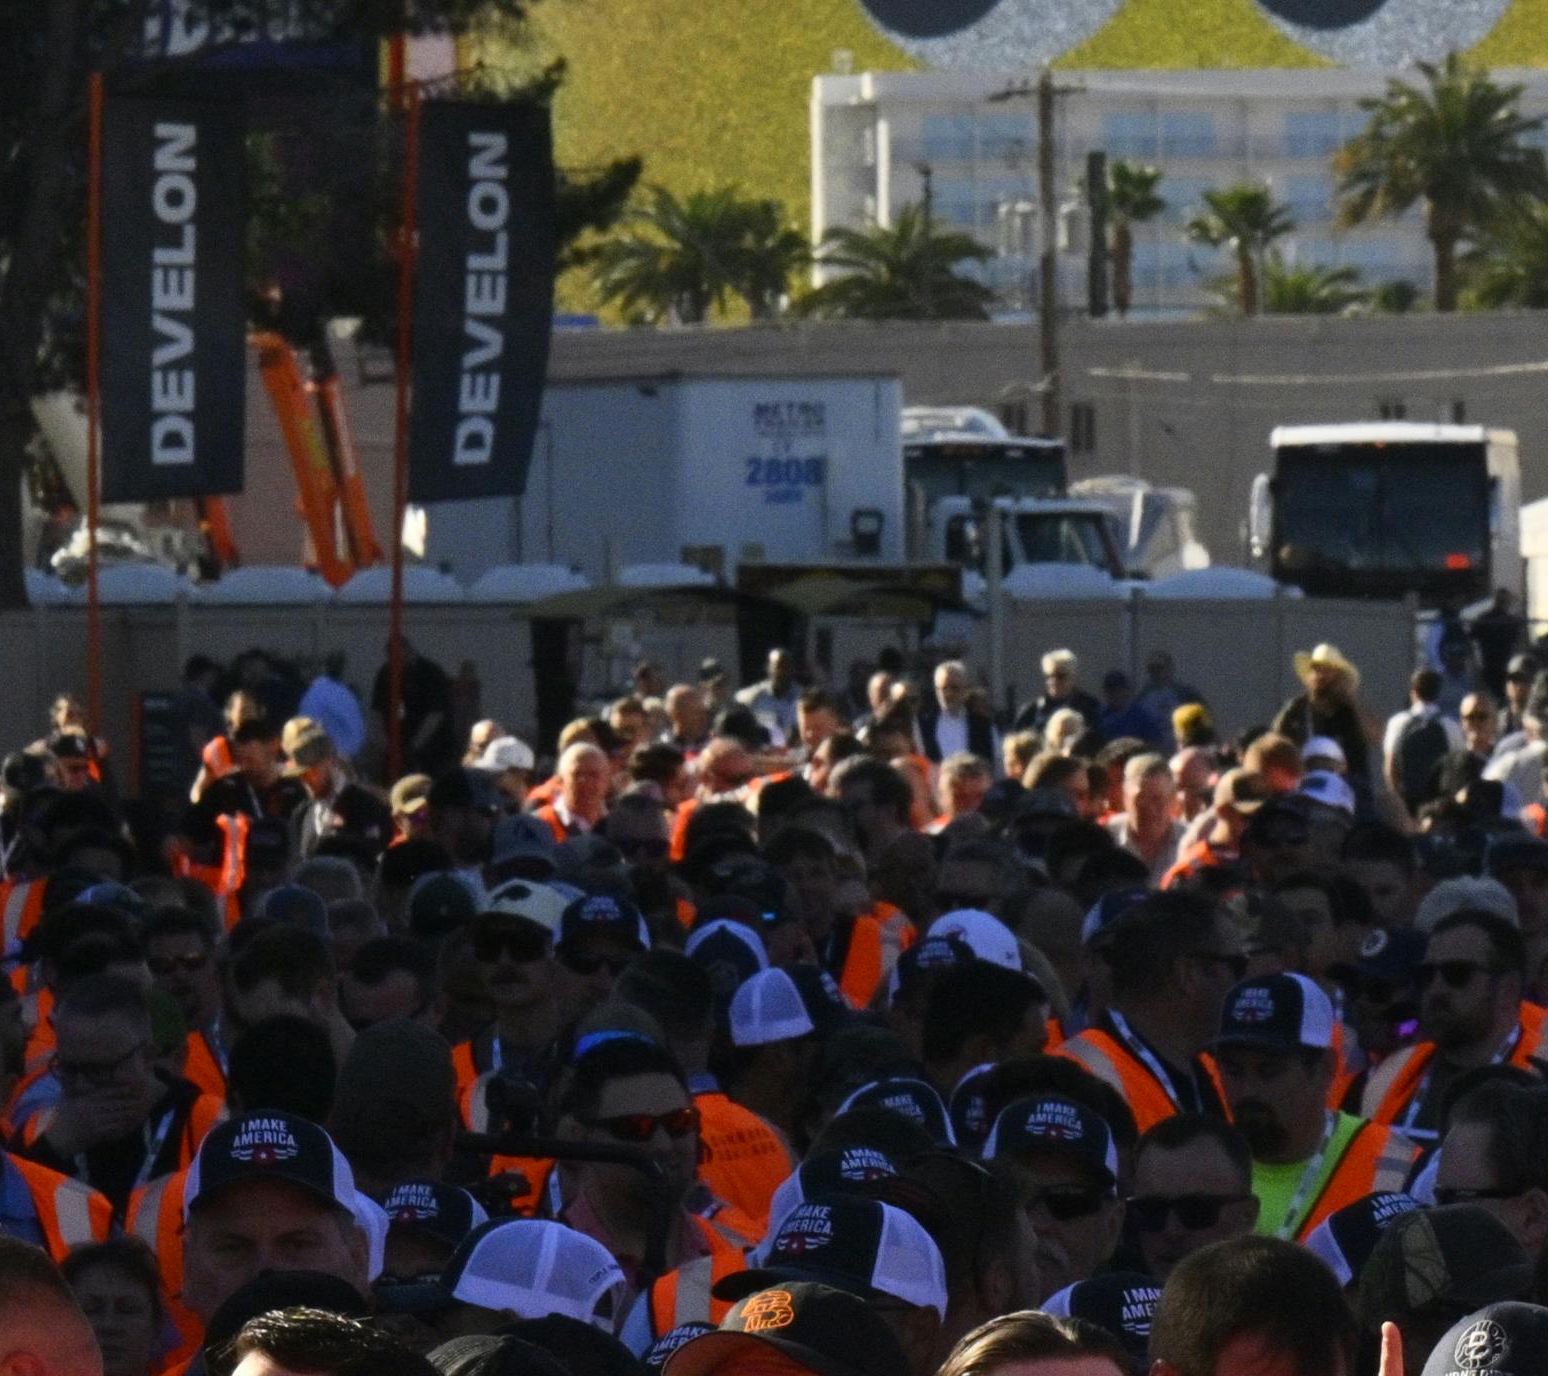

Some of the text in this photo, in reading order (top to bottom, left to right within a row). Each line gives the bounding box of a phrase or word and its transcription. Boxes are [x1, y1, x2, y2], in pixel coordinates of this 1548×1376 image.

[151, 122, 198, 466] DEVELON
[453, 132, 508, 466] DEVELON
[1041, 1103, 1078, 1117] MAKE
[247, 1119, 286, 1131] MAKE
[1028, 1112, 1082, 1129] AMERICA
[233, 1131, 294, 1147] AMERICA
[849, 1149, 885, 1162] MAKE
[396, 1183, 432, 1197] MAKE
[384, 1195, 437, 1209] AMERICA
